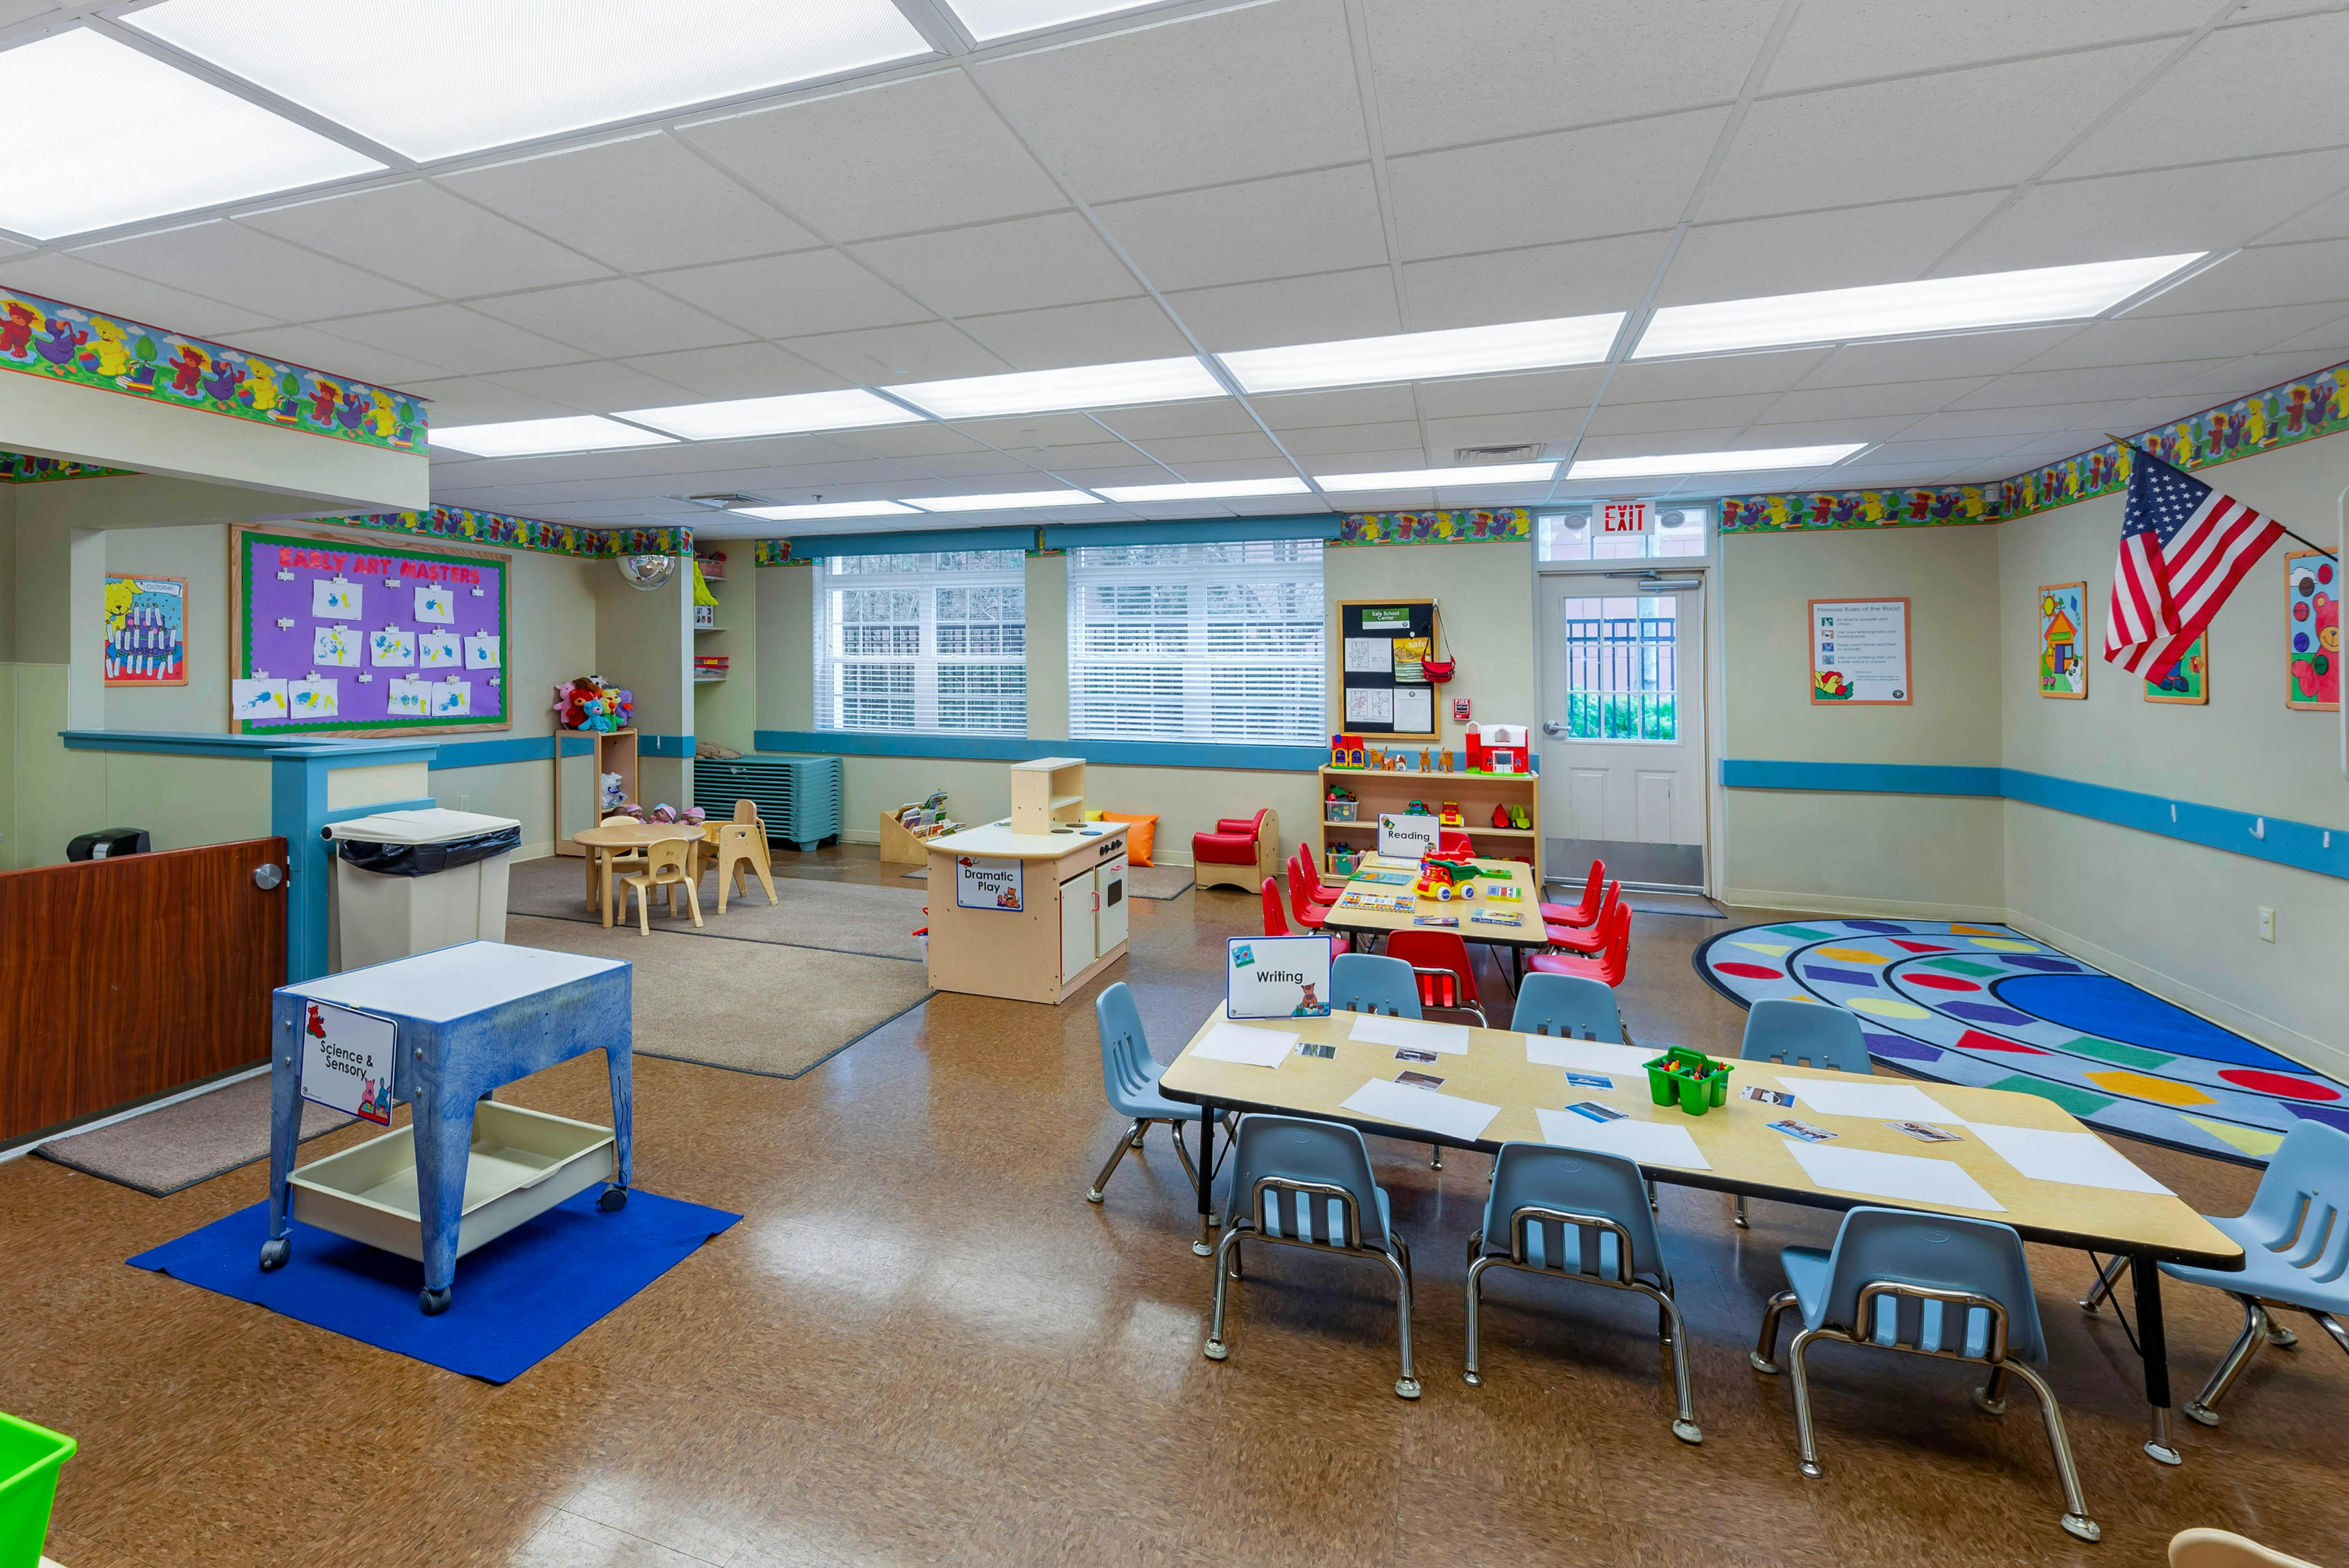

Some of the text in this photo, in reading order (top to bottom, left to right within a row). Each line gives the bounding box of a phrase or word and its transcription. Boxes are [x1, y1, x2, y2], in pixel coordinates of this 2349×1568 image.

[1605, 504, 1645, 531] EXIT
[279, 548, 479, 584] EARLY ART MASTERS
[1388, 830, 1429, 842] Reading
[965, 870, 1013, 881] Dramatic
[978, 881, 1000, 894] Play
[1256, 971, 1303, 984] Writing
[320, 1040, 373, 1068] Science &
[325, 1055, 367, 1081] Sensory
